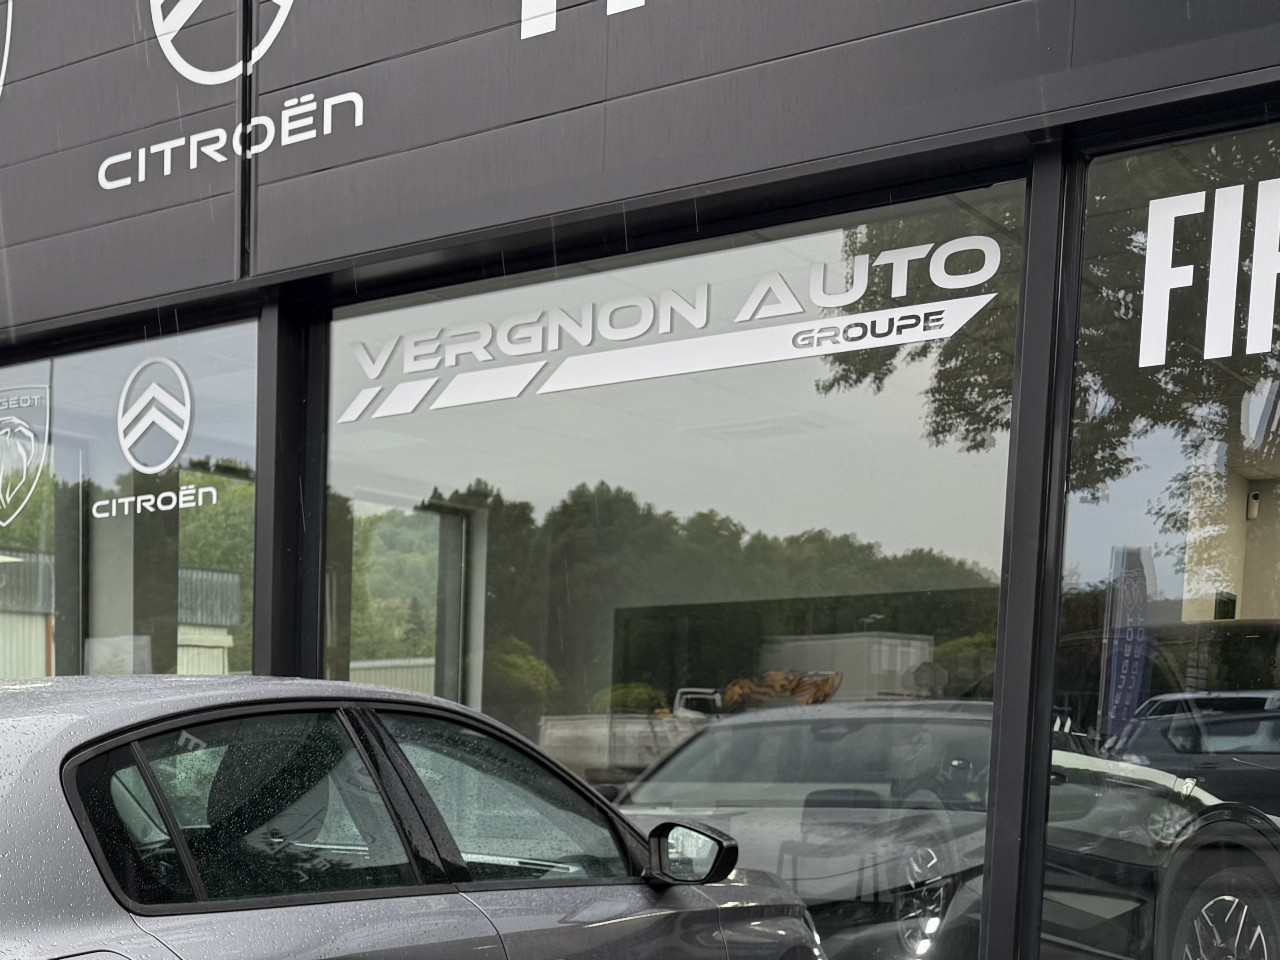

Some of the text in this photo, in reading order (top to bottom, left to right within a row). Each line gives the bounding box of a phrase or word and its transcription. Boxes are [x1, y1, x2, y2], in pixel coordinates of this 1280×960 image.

[351, 235, 1001, 380] VERGNON AUTO
[791, 309, 945, 350] GROUPE
